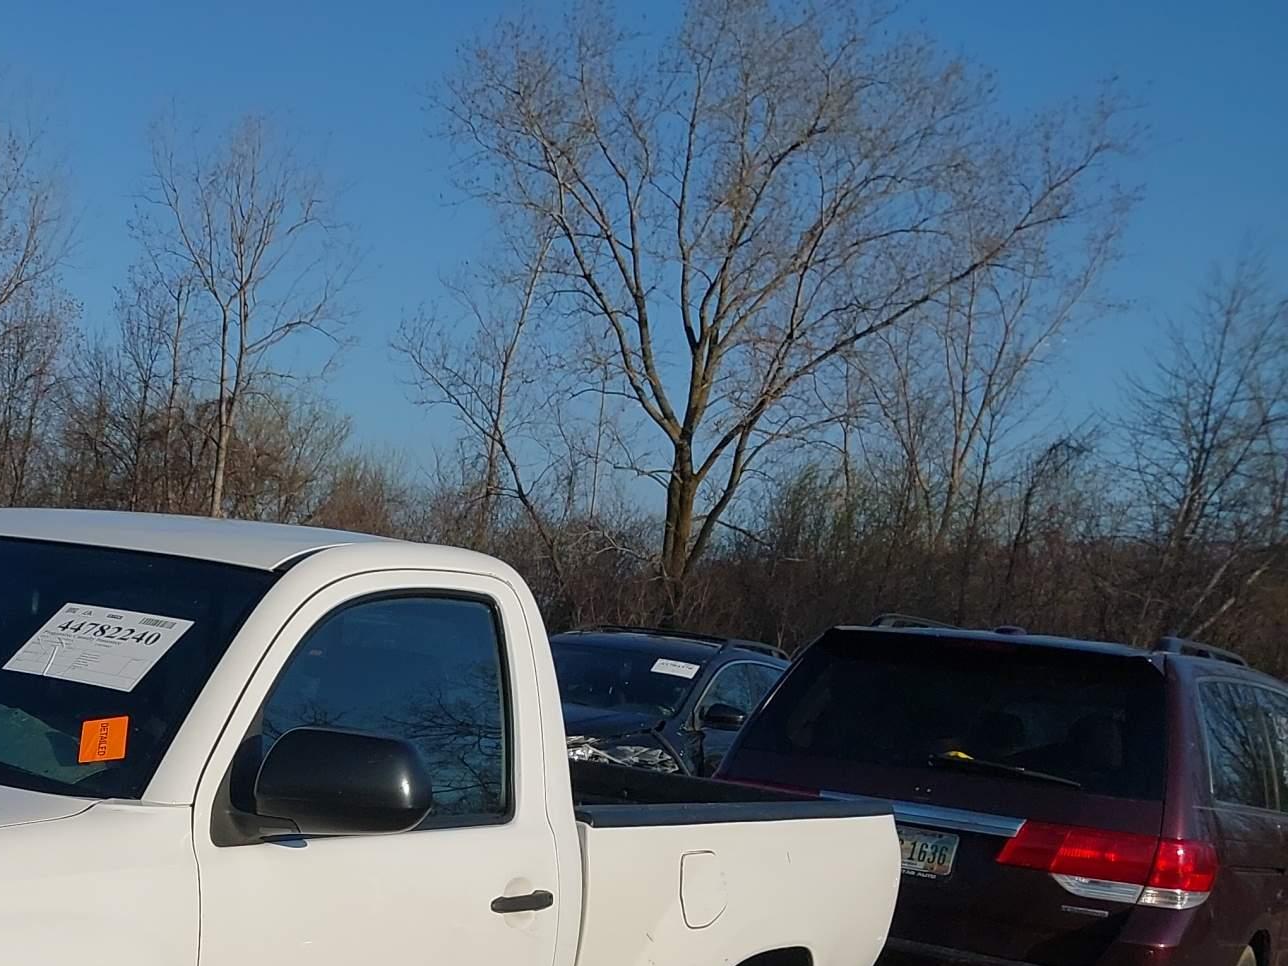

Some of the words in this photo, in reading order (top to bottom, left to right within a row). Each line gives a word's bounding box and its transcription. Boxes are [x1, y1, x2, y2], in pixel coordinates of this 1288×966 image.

[57, 619, 153, 647] 44782240
[97, 722, 109, 756] DETAILED
[906, 840, 949, 865] 1636
